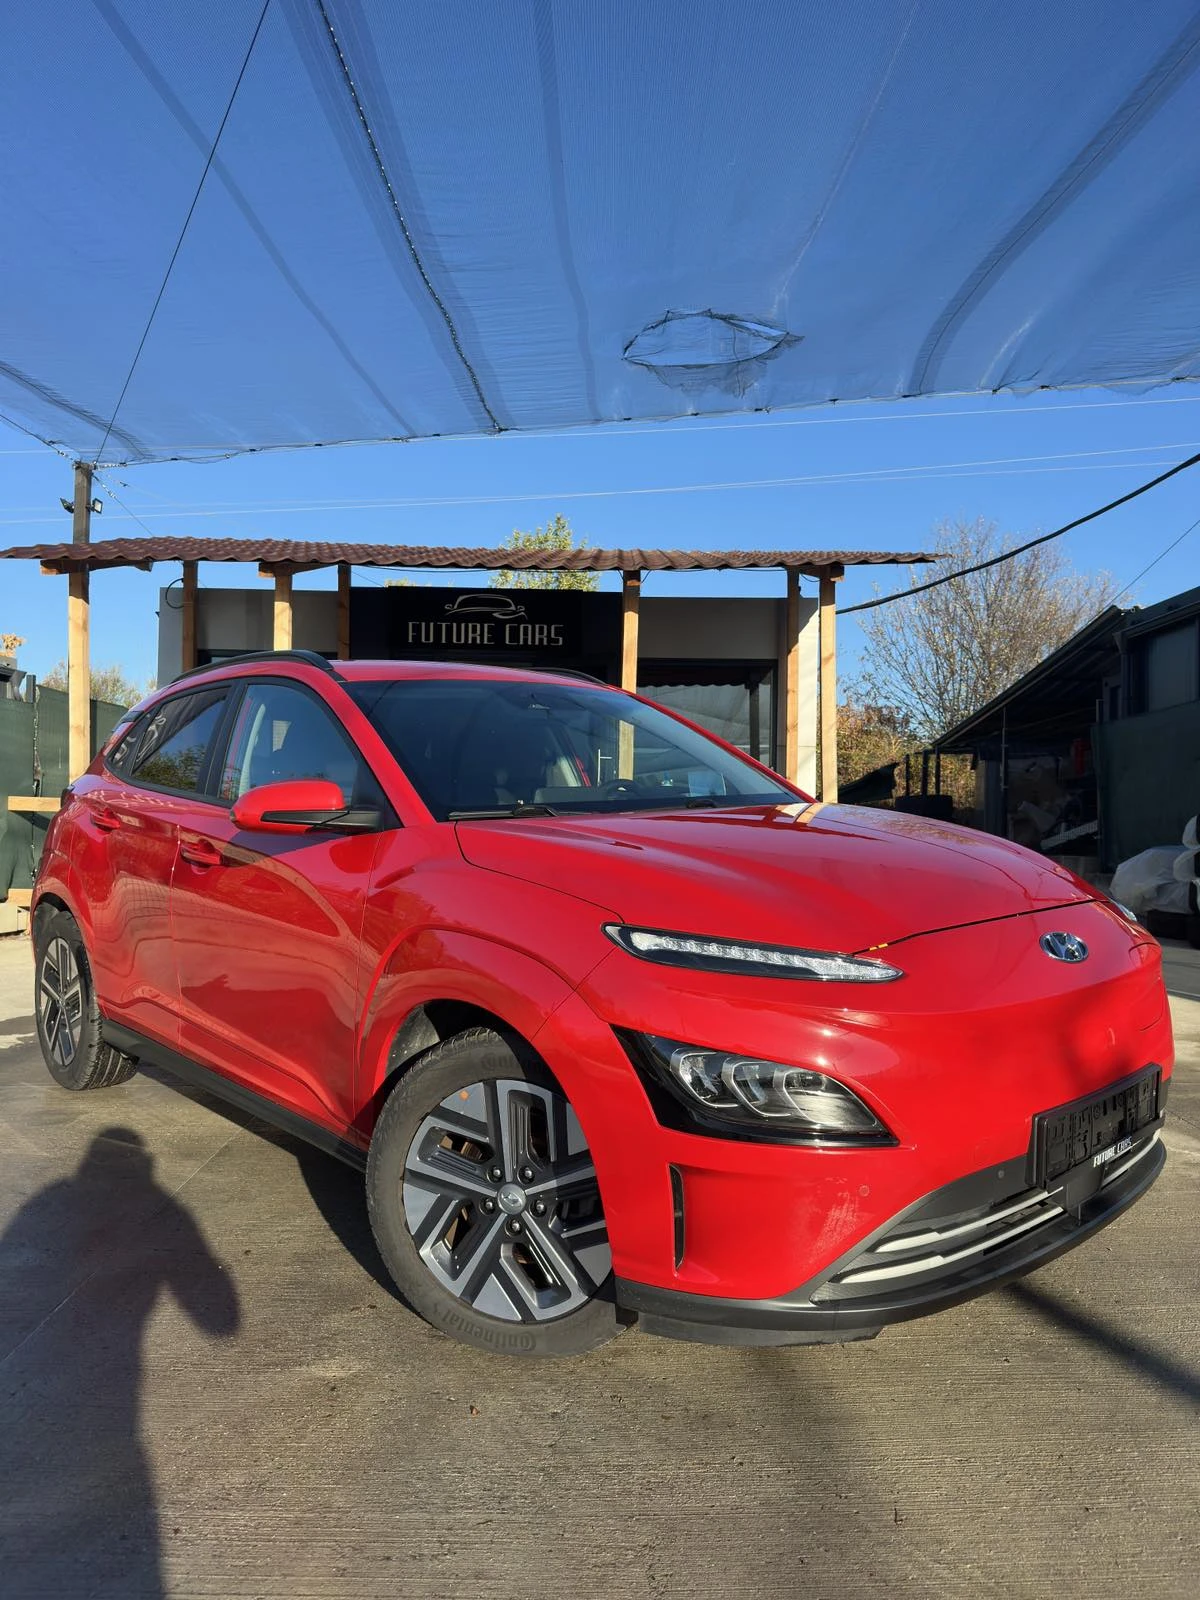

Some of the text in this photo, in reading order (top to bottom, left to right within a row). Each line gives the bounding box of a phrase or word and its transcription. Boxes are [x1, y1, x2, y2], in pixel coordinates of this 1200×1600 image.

[408, 621, 564, 646] FUTURE CARS
[1093, 1136, 1132, 1168] FUTURE CARS
[442, 1309, 537, 1352] Continental
